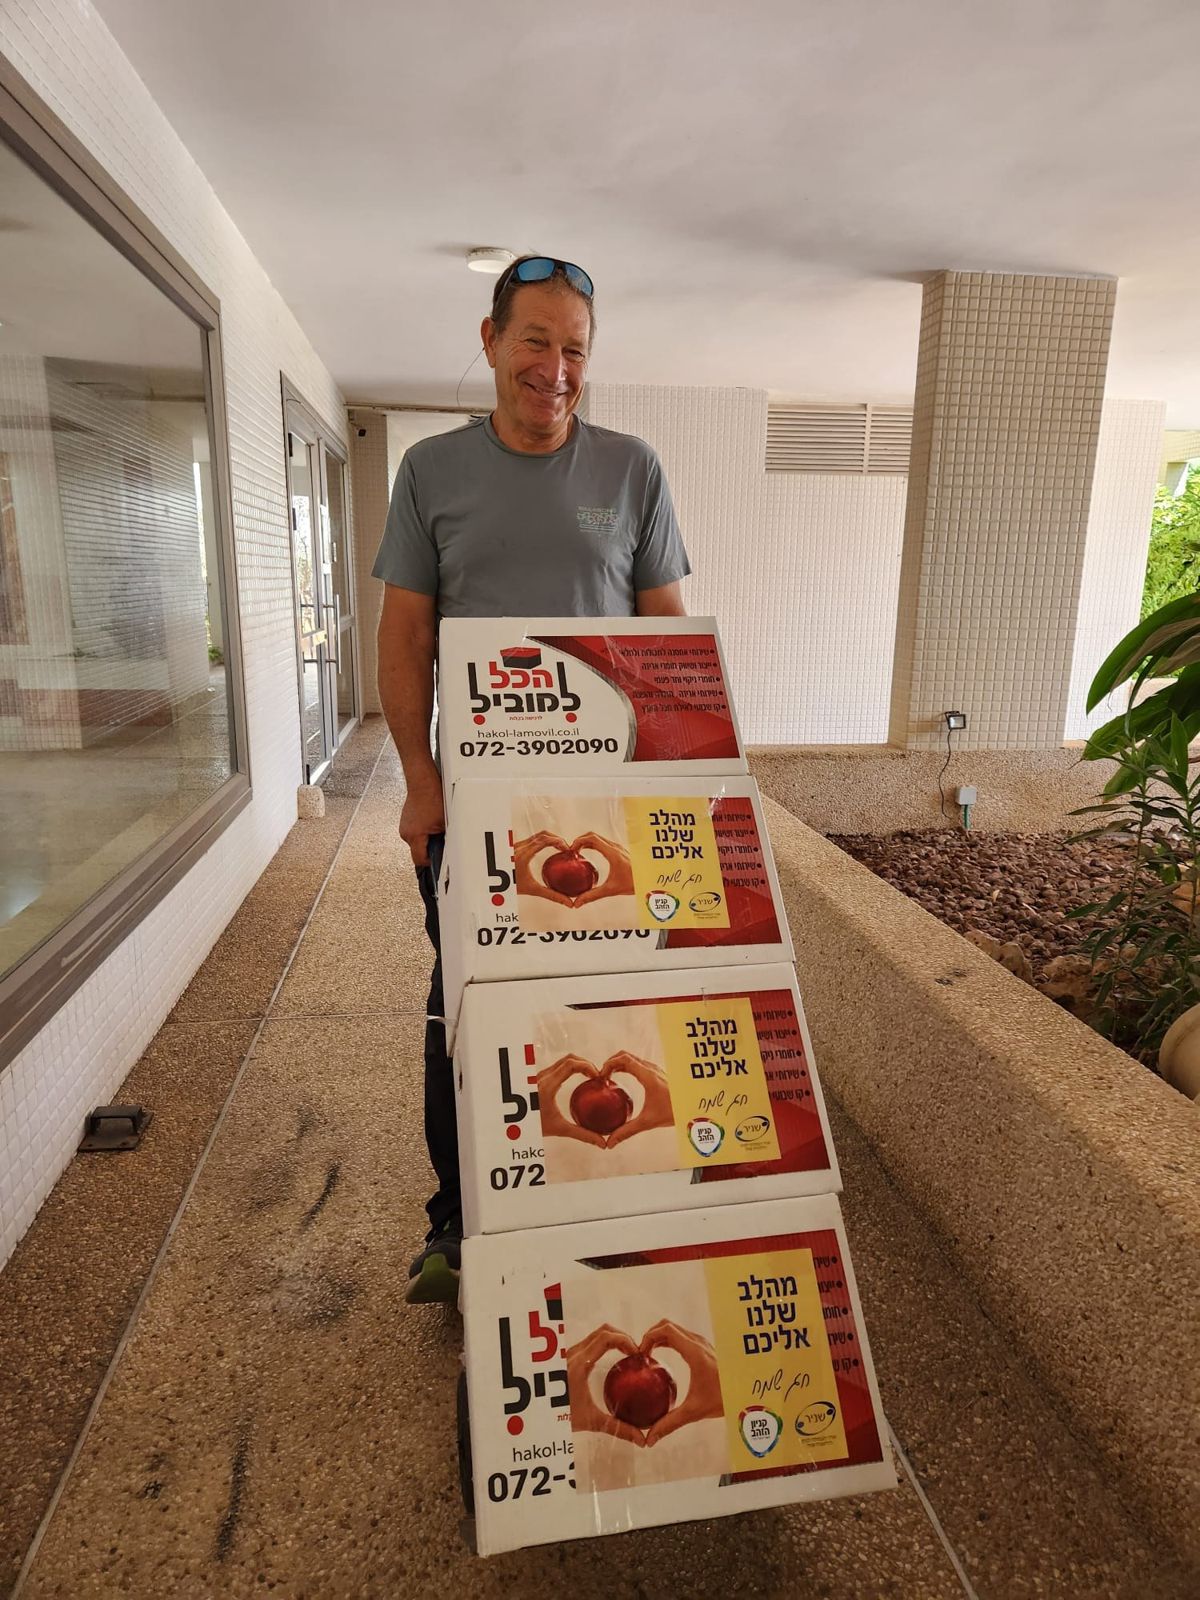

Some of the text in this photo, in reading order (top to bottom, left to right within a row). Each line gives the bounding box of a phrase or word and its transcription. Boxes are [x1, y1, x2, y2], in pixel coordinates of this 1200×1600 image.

[488, 661, 554, 689] הכל
[467, 661, 581, 714] למוביל
[477, 727, 580, 739] hakol-lamovil.co.il
[459, 738, 619, 758] 072-3902090
[649, 808, 696, 826] מהלב
[655, 825, 694, 842] שלנו
[651, 842, 704, 859] אליכם
[657, 869, 682, 887] שמח
[681, 873, 703, 890] חג
[495, 913, 519, 923] hak
[685, 1017, 738, 1038] מהלב
[693, 1037, 736, 1058] שלנו
[690, 1056, 748, 1079] אליכם
[698, 1090, 748, 1116] חג שמח
[743, 1124, 761, 1133] שניר
[490, 1163, 546, 1191] 072
[737, 1274, 798, 1302] מהלב
[746, 1300, 796, 1327] שלנו
[743, 1325, 811, 1355] אליכם
[751, 1368, 810, 1402] חג שמח
[750, 1418, 768, 1430] קניון
[805, 1411, 827, 1424] שניר
[750, 1427, 770, 1438] הזהב
[512, 1439, 574, 1463] hakol-la
